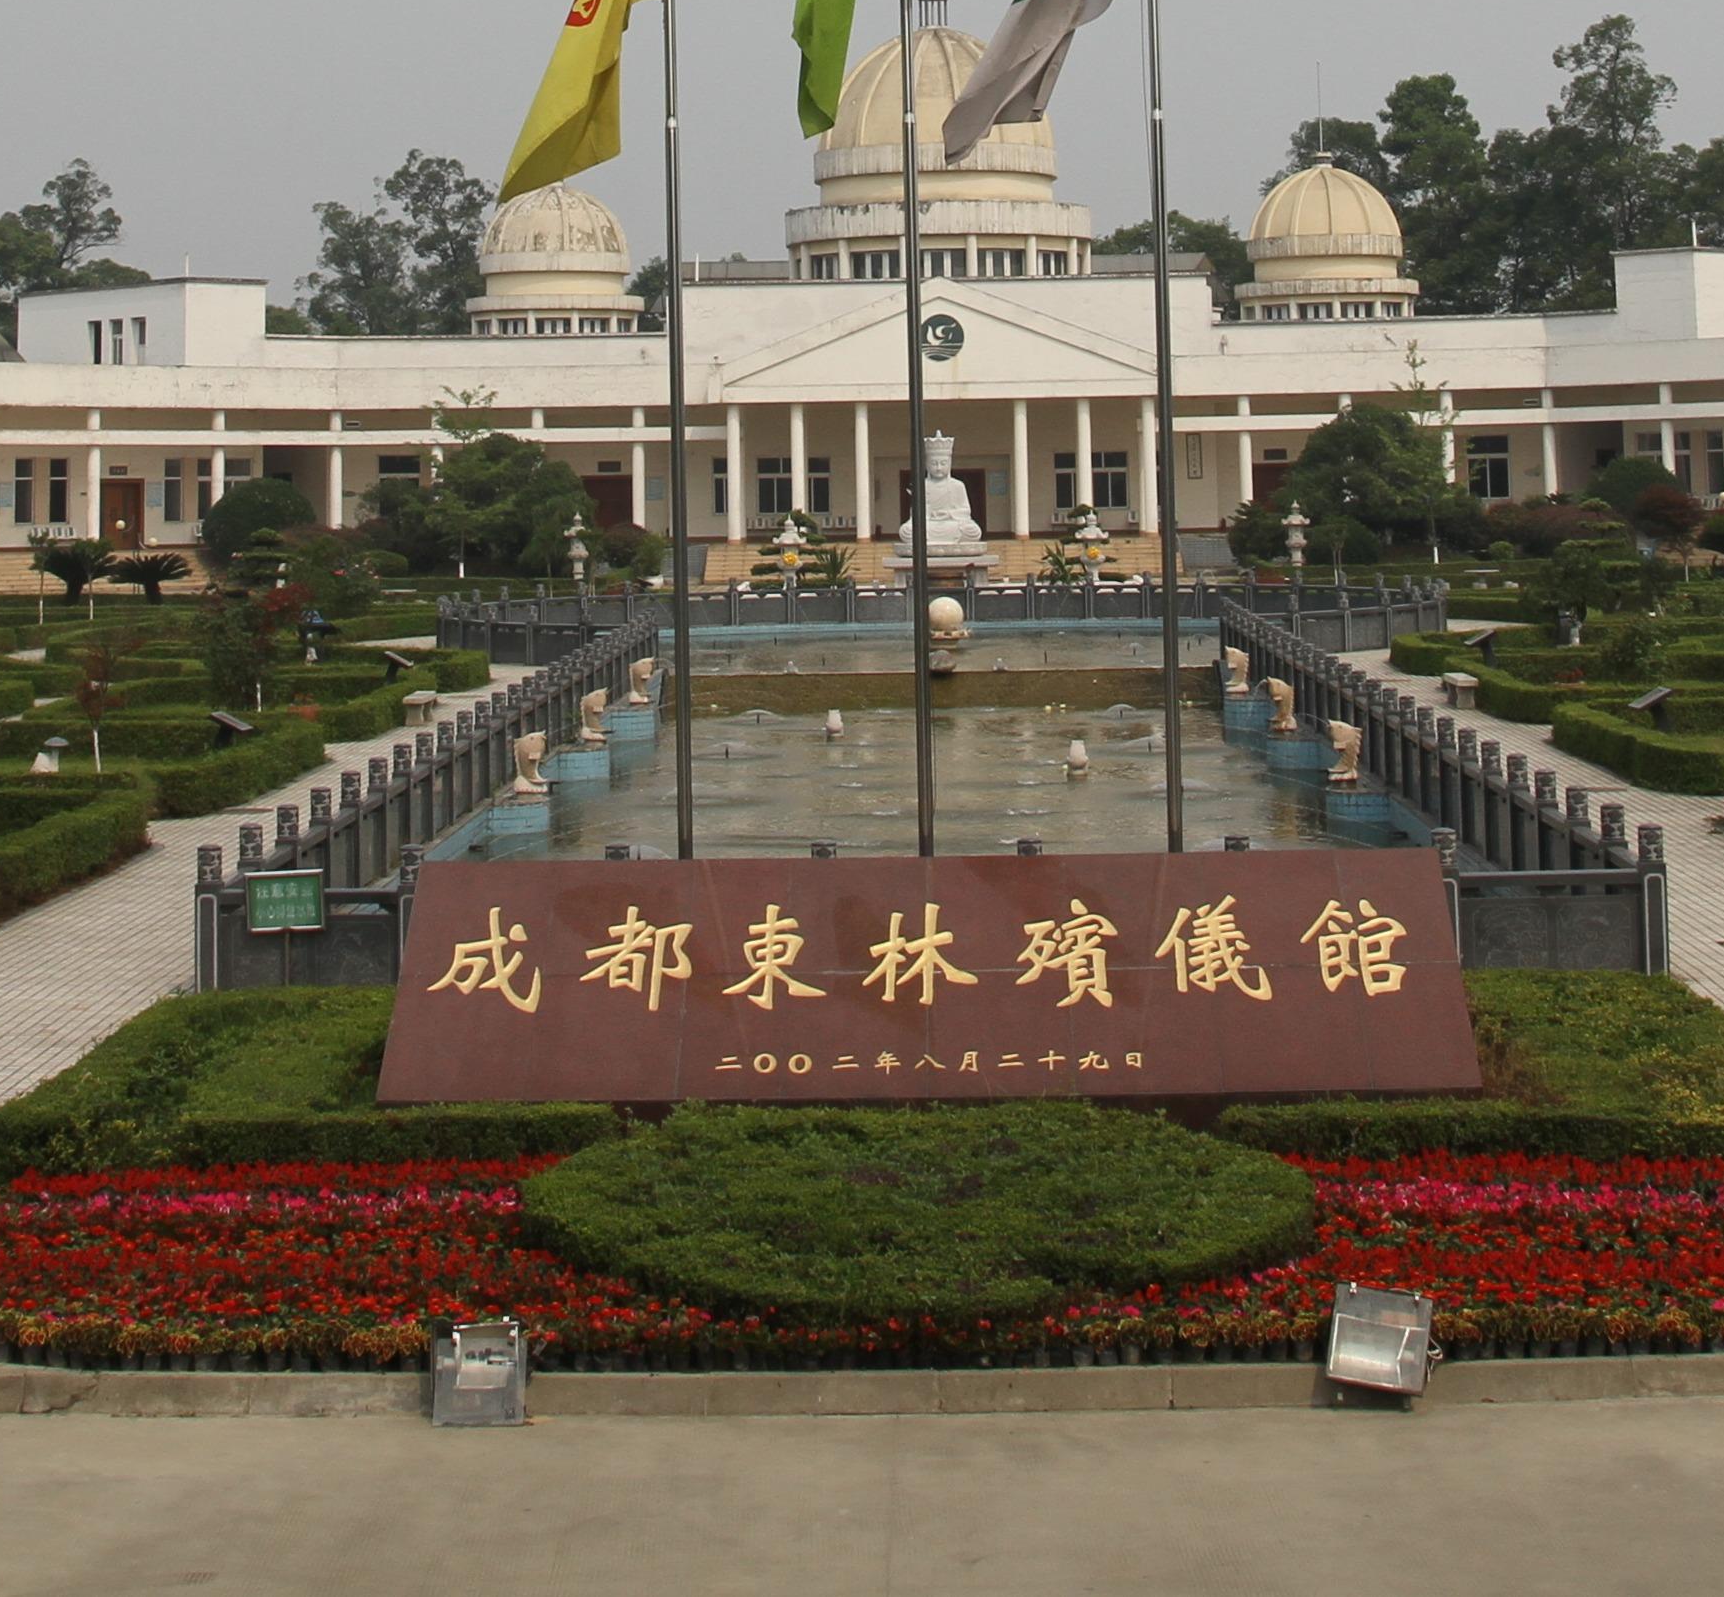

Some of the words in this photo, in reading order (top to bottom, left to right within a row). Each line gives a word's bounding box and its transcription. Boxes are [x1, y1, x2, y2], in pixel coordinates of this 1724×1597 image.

[427, 894, 1407, 1014] 成都東林殯儀館
